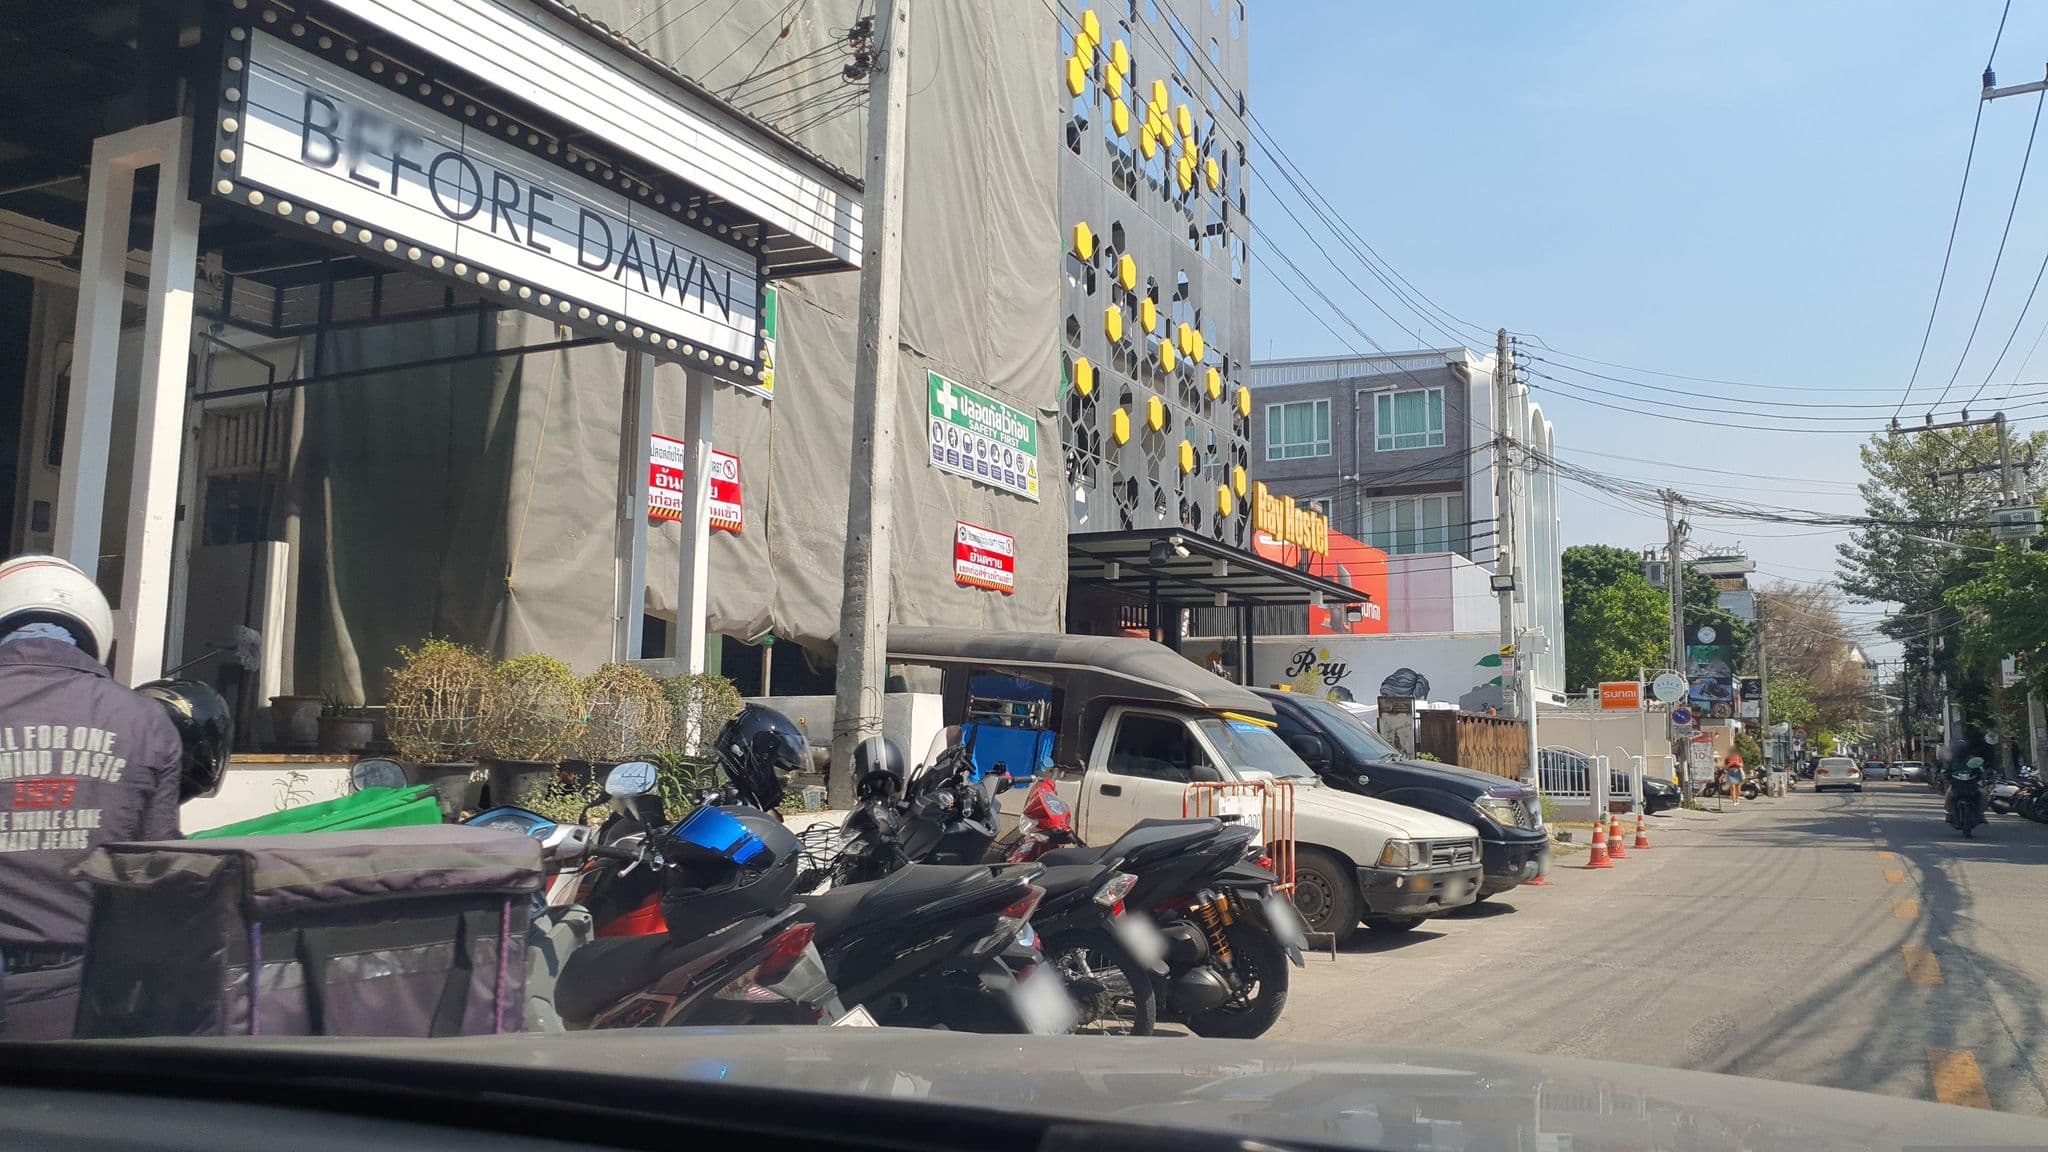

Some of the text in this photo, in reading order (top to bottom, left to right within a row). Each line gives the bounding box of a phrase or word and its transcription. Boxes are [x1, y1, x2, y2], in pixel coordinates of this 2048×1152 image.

[577, 207, 732, 323] DAWN
[969, 419, 1020, 448] SAFETY FIRST
[1253, 481, 1329, 557] Ray Hostel
[1286, 646, 1352, 686] Ray
[23, 725, 68, 749] FOR
[71, 726, 118, 754] ONE
[60, 750, 127, 783] BASIC
[63, 809, 76, 829] &
